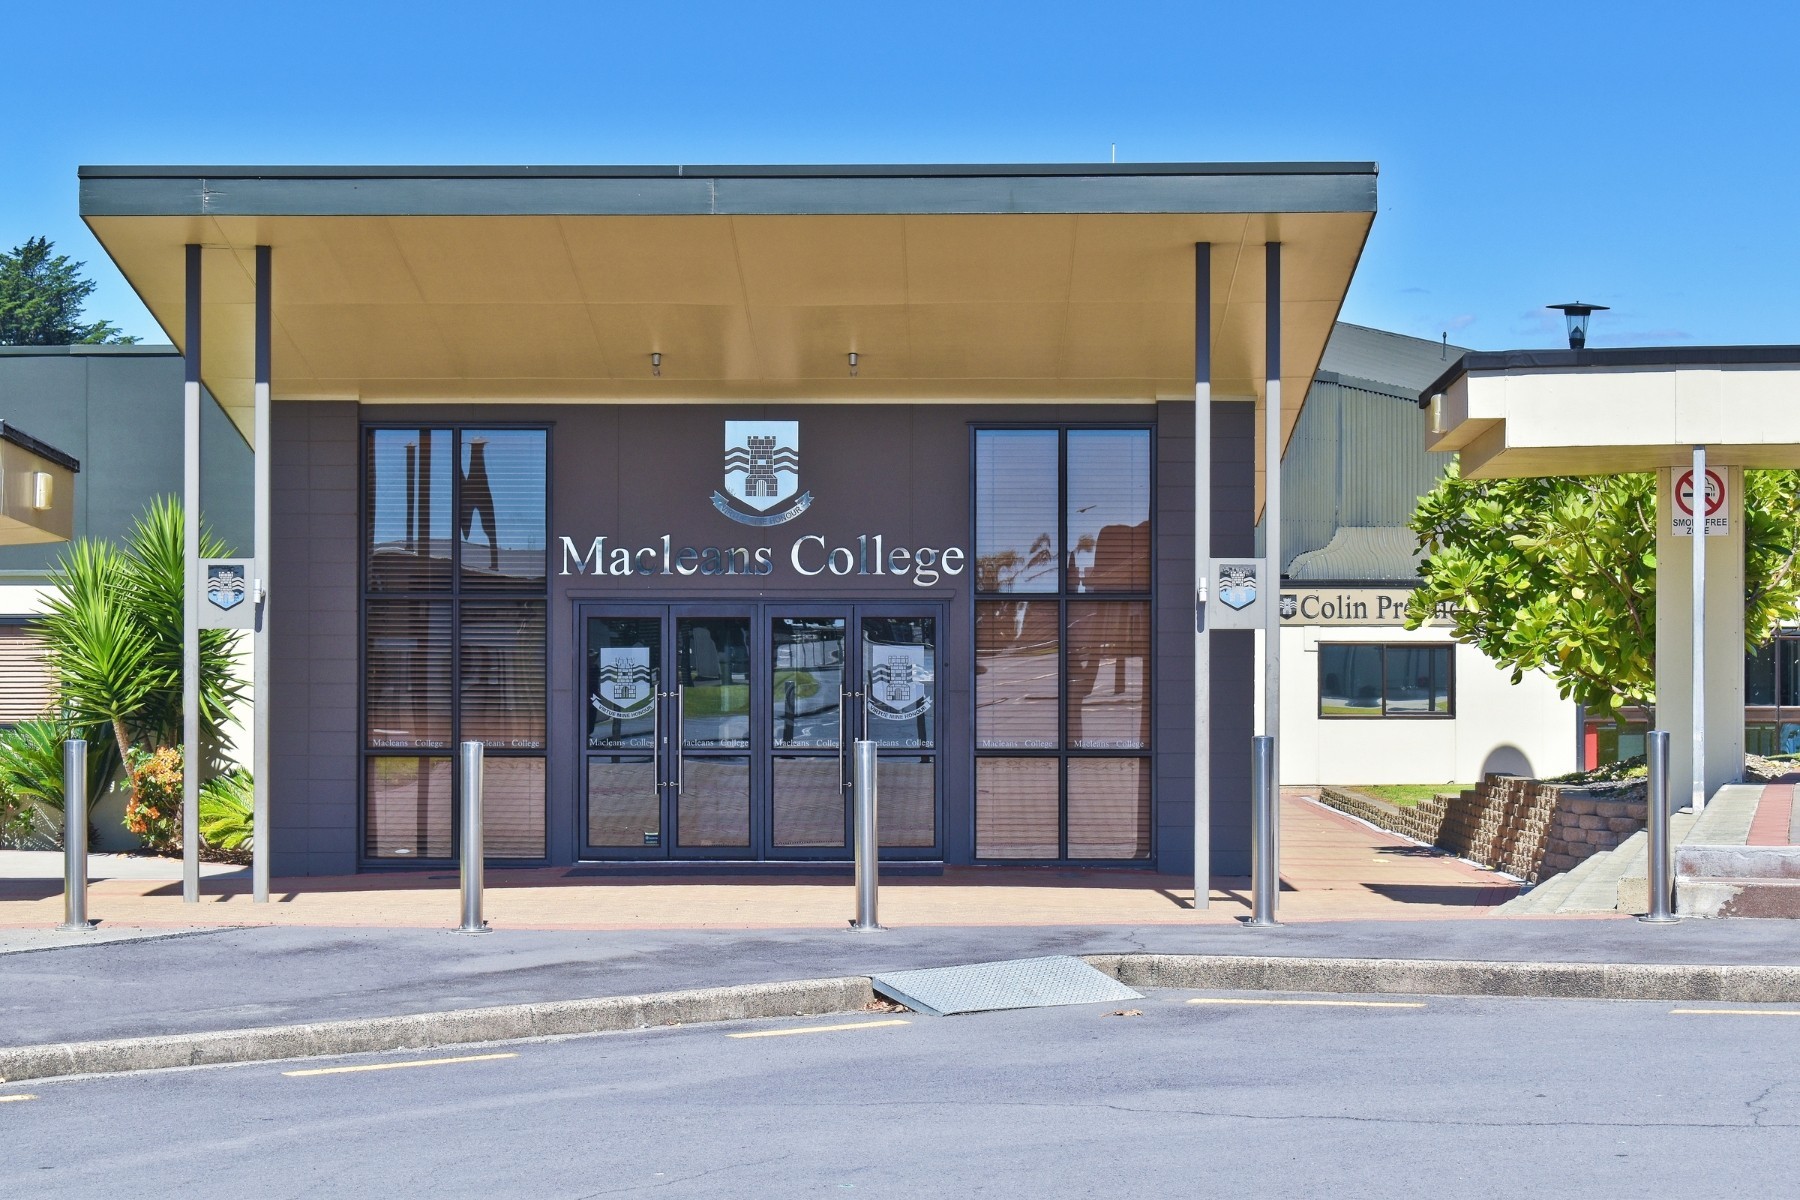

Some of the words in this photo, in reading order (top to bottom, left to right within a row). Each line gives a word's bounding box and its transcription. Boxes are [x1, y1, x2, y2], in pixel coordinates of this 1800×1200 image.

[1673, 518, 1693, 527] SMO
[1706, 518, 1727, 526] FREE
[1686, 526, 1709, 535] ZE
[559, 535, 773, 576] Macleans
[791, 534, 964, 587] College
[1300, 594, 1368, 619] Colin
[373, 739, 408, 747] Macleans
[414, 739, 443, 748] College
[470, 739, 505, 747] cleans
[511, 739, 539, 748] College
[589, 739, 625, 747] Macleans
[630, 739, 654, 748] Colleg
[720, 739, 749, 748] College
[774, 739, 810, 747] Macleans
[816, 739, 844, 748] Colleg
[870, 739, 899, 747] cleans
[905, 739, 933, 748] College
[982, 739, 1018, 747] Macleans
[1024, 739, 1053, 748] College
[1074, 739, 1109, 748] Macleans
[1116, 740, 1144, 749] College
